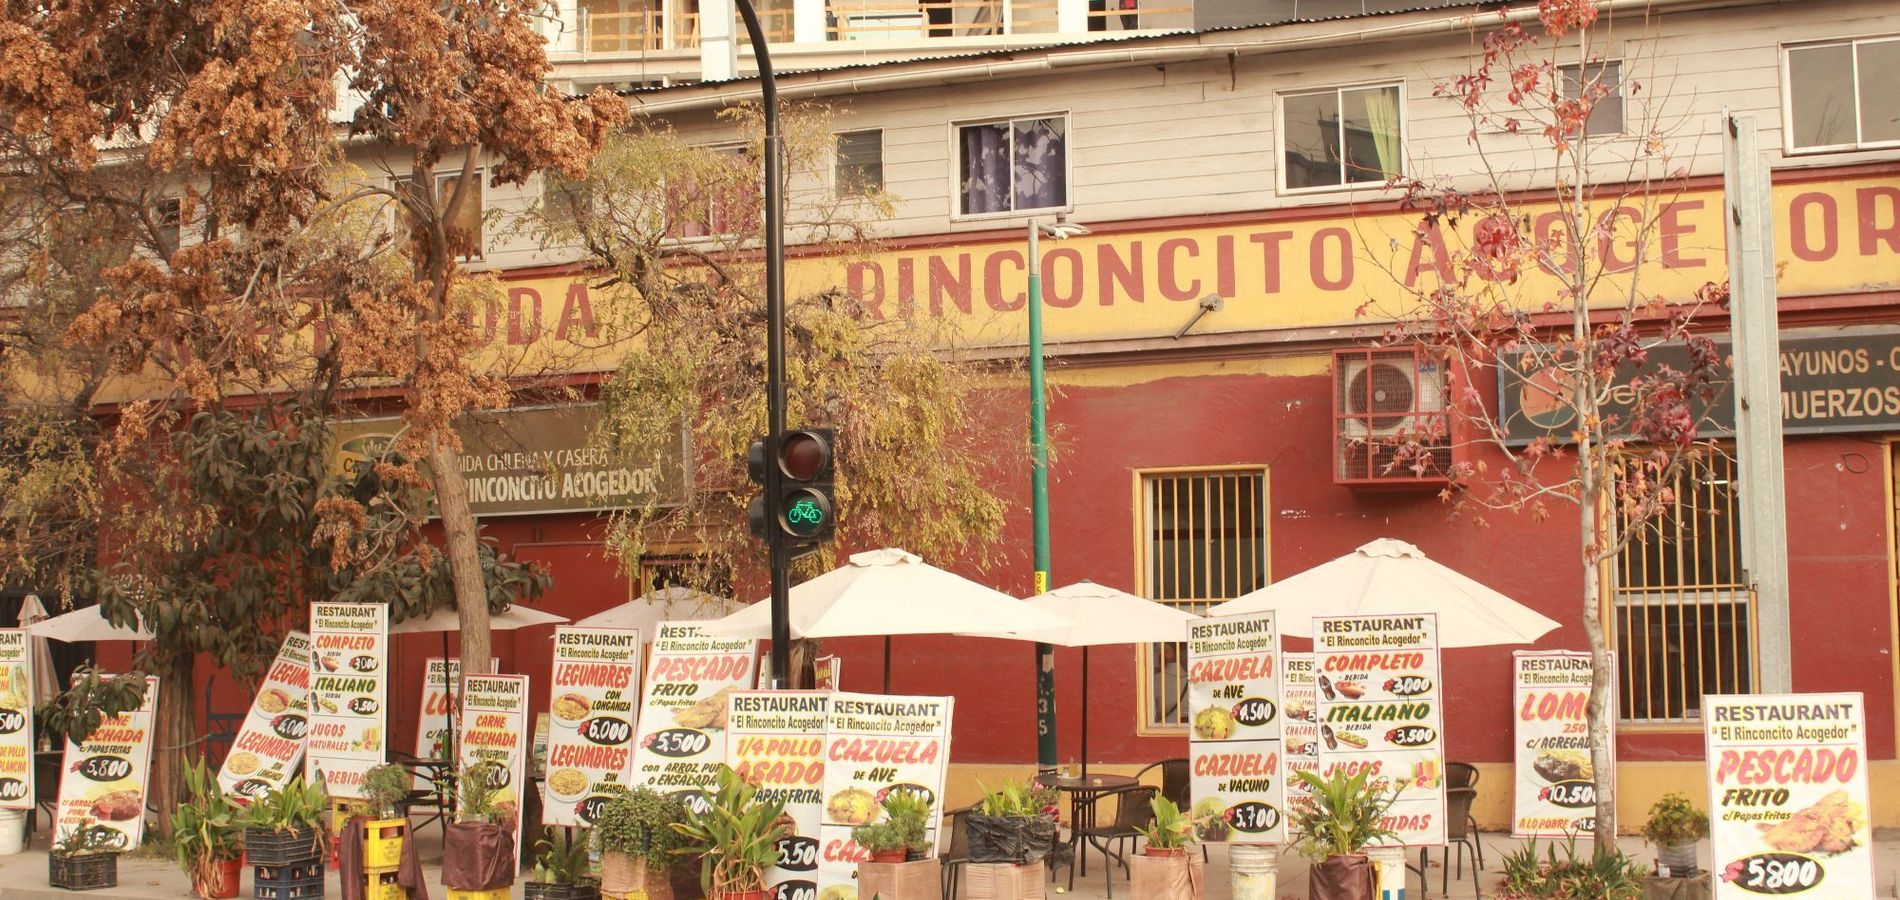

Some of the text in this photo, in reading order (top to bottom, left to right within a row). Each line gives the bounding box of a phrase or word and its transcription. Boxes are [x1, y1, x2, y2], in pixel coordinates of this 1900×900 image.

[847, 187, 1900, 321] RINCONCITO ACOGEOR
[464, 283, 598, 346] ODA
[1780, 348, 1869, 376] AYUNOS
[1780, 386, 1900, 419] UERZOS
[457, 455, 484, 472] IDA
[543, 451, 553, 468] Y
[557, 448, 609, 467] CASERA
[466, 475, 557, 502] INCONCITO
[317, 606, 376, 618] RESTAURANT
[1192, 619, 1270, 639] RESTAURANT
[1323, 617, 1425, 633] RESTAURANT
[316, 634, 376, 651] COMPLETO
[559, 633, 633, 647] RESTAURANT
[669, 640, 709, 652] Rinconcito
[1201, 639, 1236, 653] Rinconcito
[1337, 634, 1381, 647] Rinconcito
[567, 648, 599, 660] Rinconcito
[1324, 652, 1424, 672] COMPLETO
[555, 663, 632, 689] LEGUMBRES
[652, 656, 750, 682] PESCADO
[1189, 654, 1273, 684] CAZUELA
[1345, 673, 1369, 681] BEBIDA
[314, 676, 376, 692] ITALIANO
[467, 679, 521, 694] RESTAURANT
[1532, 673, 1569, 684] Rinconcito
[605, 690, 621, 700] CON
[652, 683, 698, 696] FRITO
[1213, 685, 1245, 699] DE AVE
[592, 700, 631, 712] LONGANIZA
[734, 697, 828, 712] RESTAURANT
[834, 700, 940, 717] RESTAURANT
[1326, 702, 1431, 723] ITALIANO
[1520, 692, 1589, 722] LOM
[1715, 704, 1853, 722] RESTAURANT
[476, 714, 507, 729] CARNE
[746, 715, 786, 729] Rinconcito
[847, 717, 892, 732] Rinconcito
[1345, 723, 1372, 731] BEBIDA
[1563, 723, 1586, 734] 250
[85, 729, 144, 743] ECHADA
[310, 723, 346, 737] JUGOS
[1734, 725, 1793, 741] Rinconcito
[236, 730, 301, 762] LEGUMBRES
[309, 740, 349, 751] NATURALES
[464, 730, 517, 748] MECHADA
[1541, 736, 1591, 750] AGREGAD
[765, 737, 822, 758] POLLO
[828, 737, 940, 765] CAZUELA
[550, 743, 629, 771] LEGUMBRES
[1194, 752, 1278, 778] CAZUELA
[642, 764, 660, 772] con
[664, 762, 699, 773] ARROZ
[735, 761, 825, 785] ASADO
[1716, 747, 1858, 785] PESCADO
[327, 770, 366, 786] BEBIDA
[604, 772, 618, 782] SIN
[853, 767, 898, 783] DE AVE
[1218, 778, 1270, 793] DE VACUNO
[753, 788, 788, 804] APAS
[1721, 787, 1790, 807] FRITO
[1539, 817, 1569, 829] POBRE
[1763, 811, 1791, 820] Fritas
